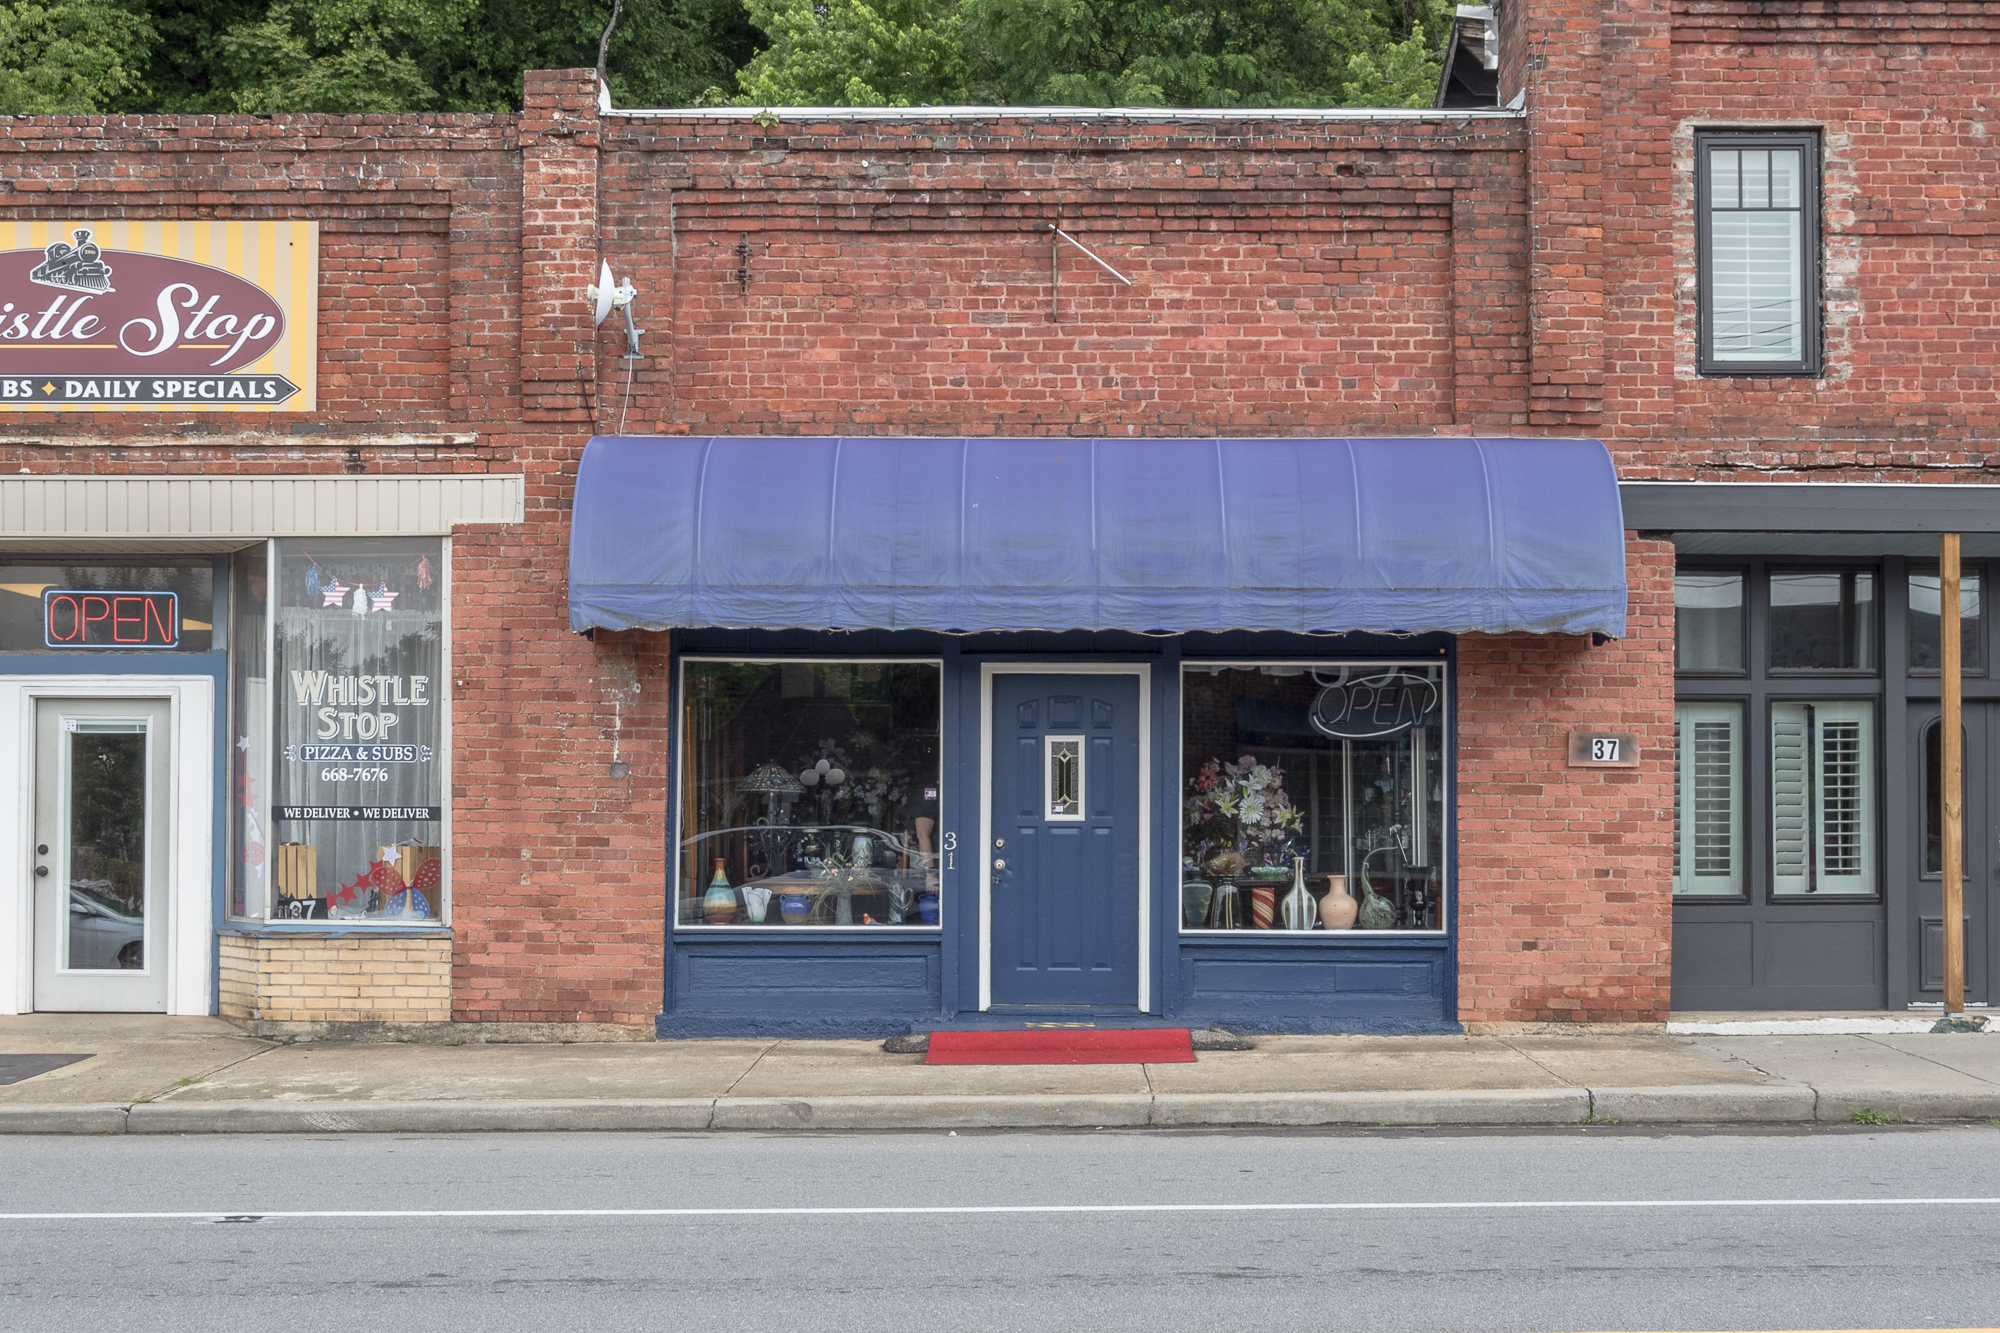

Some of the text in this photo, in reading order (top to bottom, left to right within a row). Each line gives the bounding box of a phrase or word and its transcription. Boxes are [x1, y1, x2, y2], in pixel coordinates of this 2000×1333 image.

[119, 283, 276, 367] Stop
[65, 380, 141, 398] DAILY
[152, 380, 277, 399] SPECIALS
[50, 596, 173, 642] OPEN
[290, 670, 430, 705] WHISTLE
[1317, 686, 1428, 725] OPEN
[317, 707, 399, 740] STOP
[304, 746, 413, 760] PIZZA & SUBS
[1594, 739, 1617, 760] 37
[321, 767, 388, 782] 668-7676
[284, 808, 430, 818] WE DELIVER WE DELIVER
